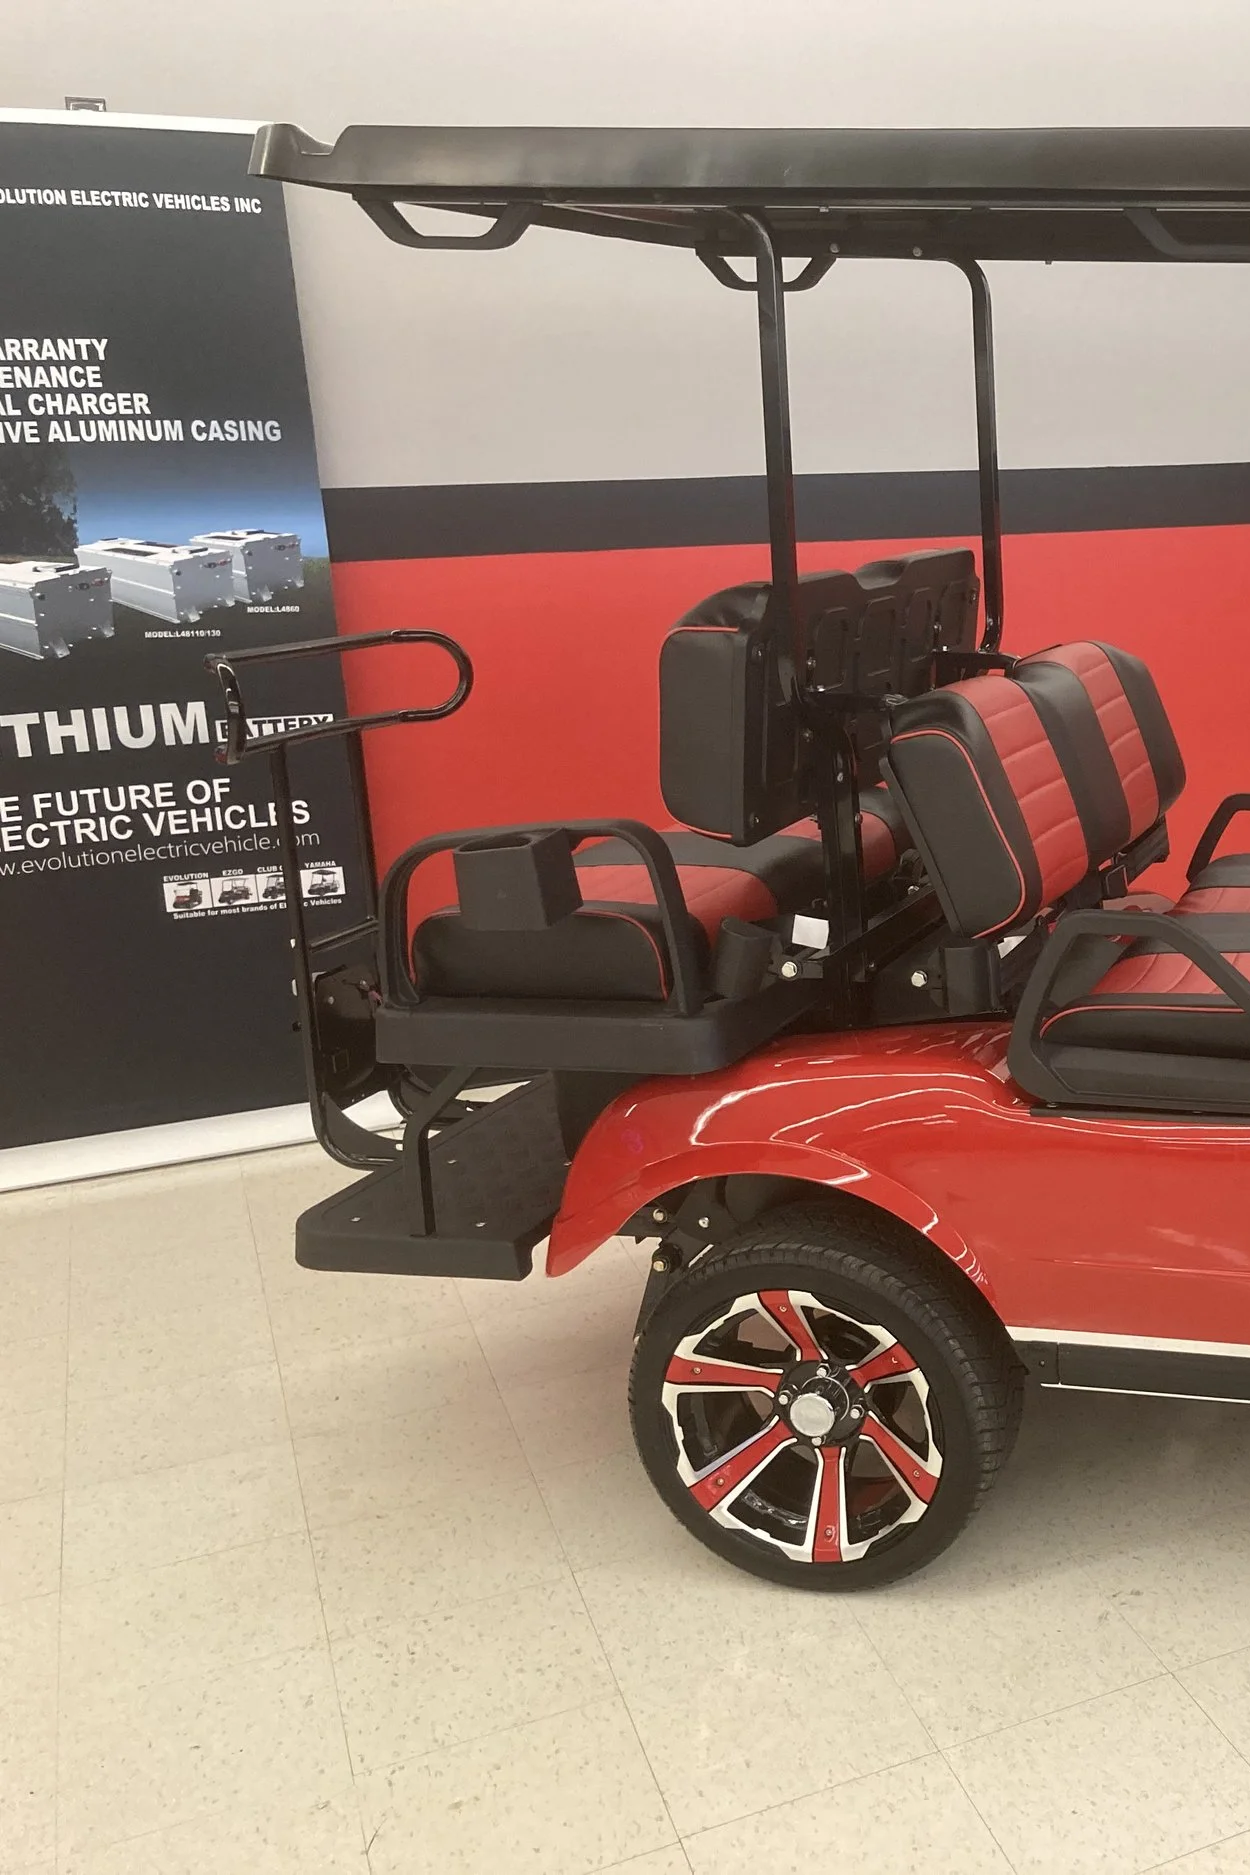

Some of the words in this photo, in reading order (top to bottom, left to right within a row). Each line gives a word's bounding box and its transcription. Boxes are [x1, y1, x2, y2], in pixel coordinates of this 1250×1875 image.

[70, 190, 150, 208] ELECTRIC
[152, 193, 231, 212] VEHICLES
[234, 197, 262, 214] INC
[28, 392, 151, 416] CHARGER
[48, 420, 184, 443] ALUMINUM
[191, 420, 282, 443] CASING
[247, 606, 300, 614] MODEL:L4860
[0, 701, 210, 758] THIUM
[33, 782, 176, 819] FUTURE
[186, 778, 231, 805] OF
[0, 815, 133, 852] ECTRIC
[222, 868, 244, 877] EZGO
[257, 865, 278, 873] CLUB
[304, 860, 336, 868] YAMAHA
[163, 872, 209, 883] EVOLUTION
[173, 910, 206, 920] Suitable
[207, 909, 219, 917] for
[241, 904, 269, 913] brands
[310, 897, 342, 906] Vehicles
